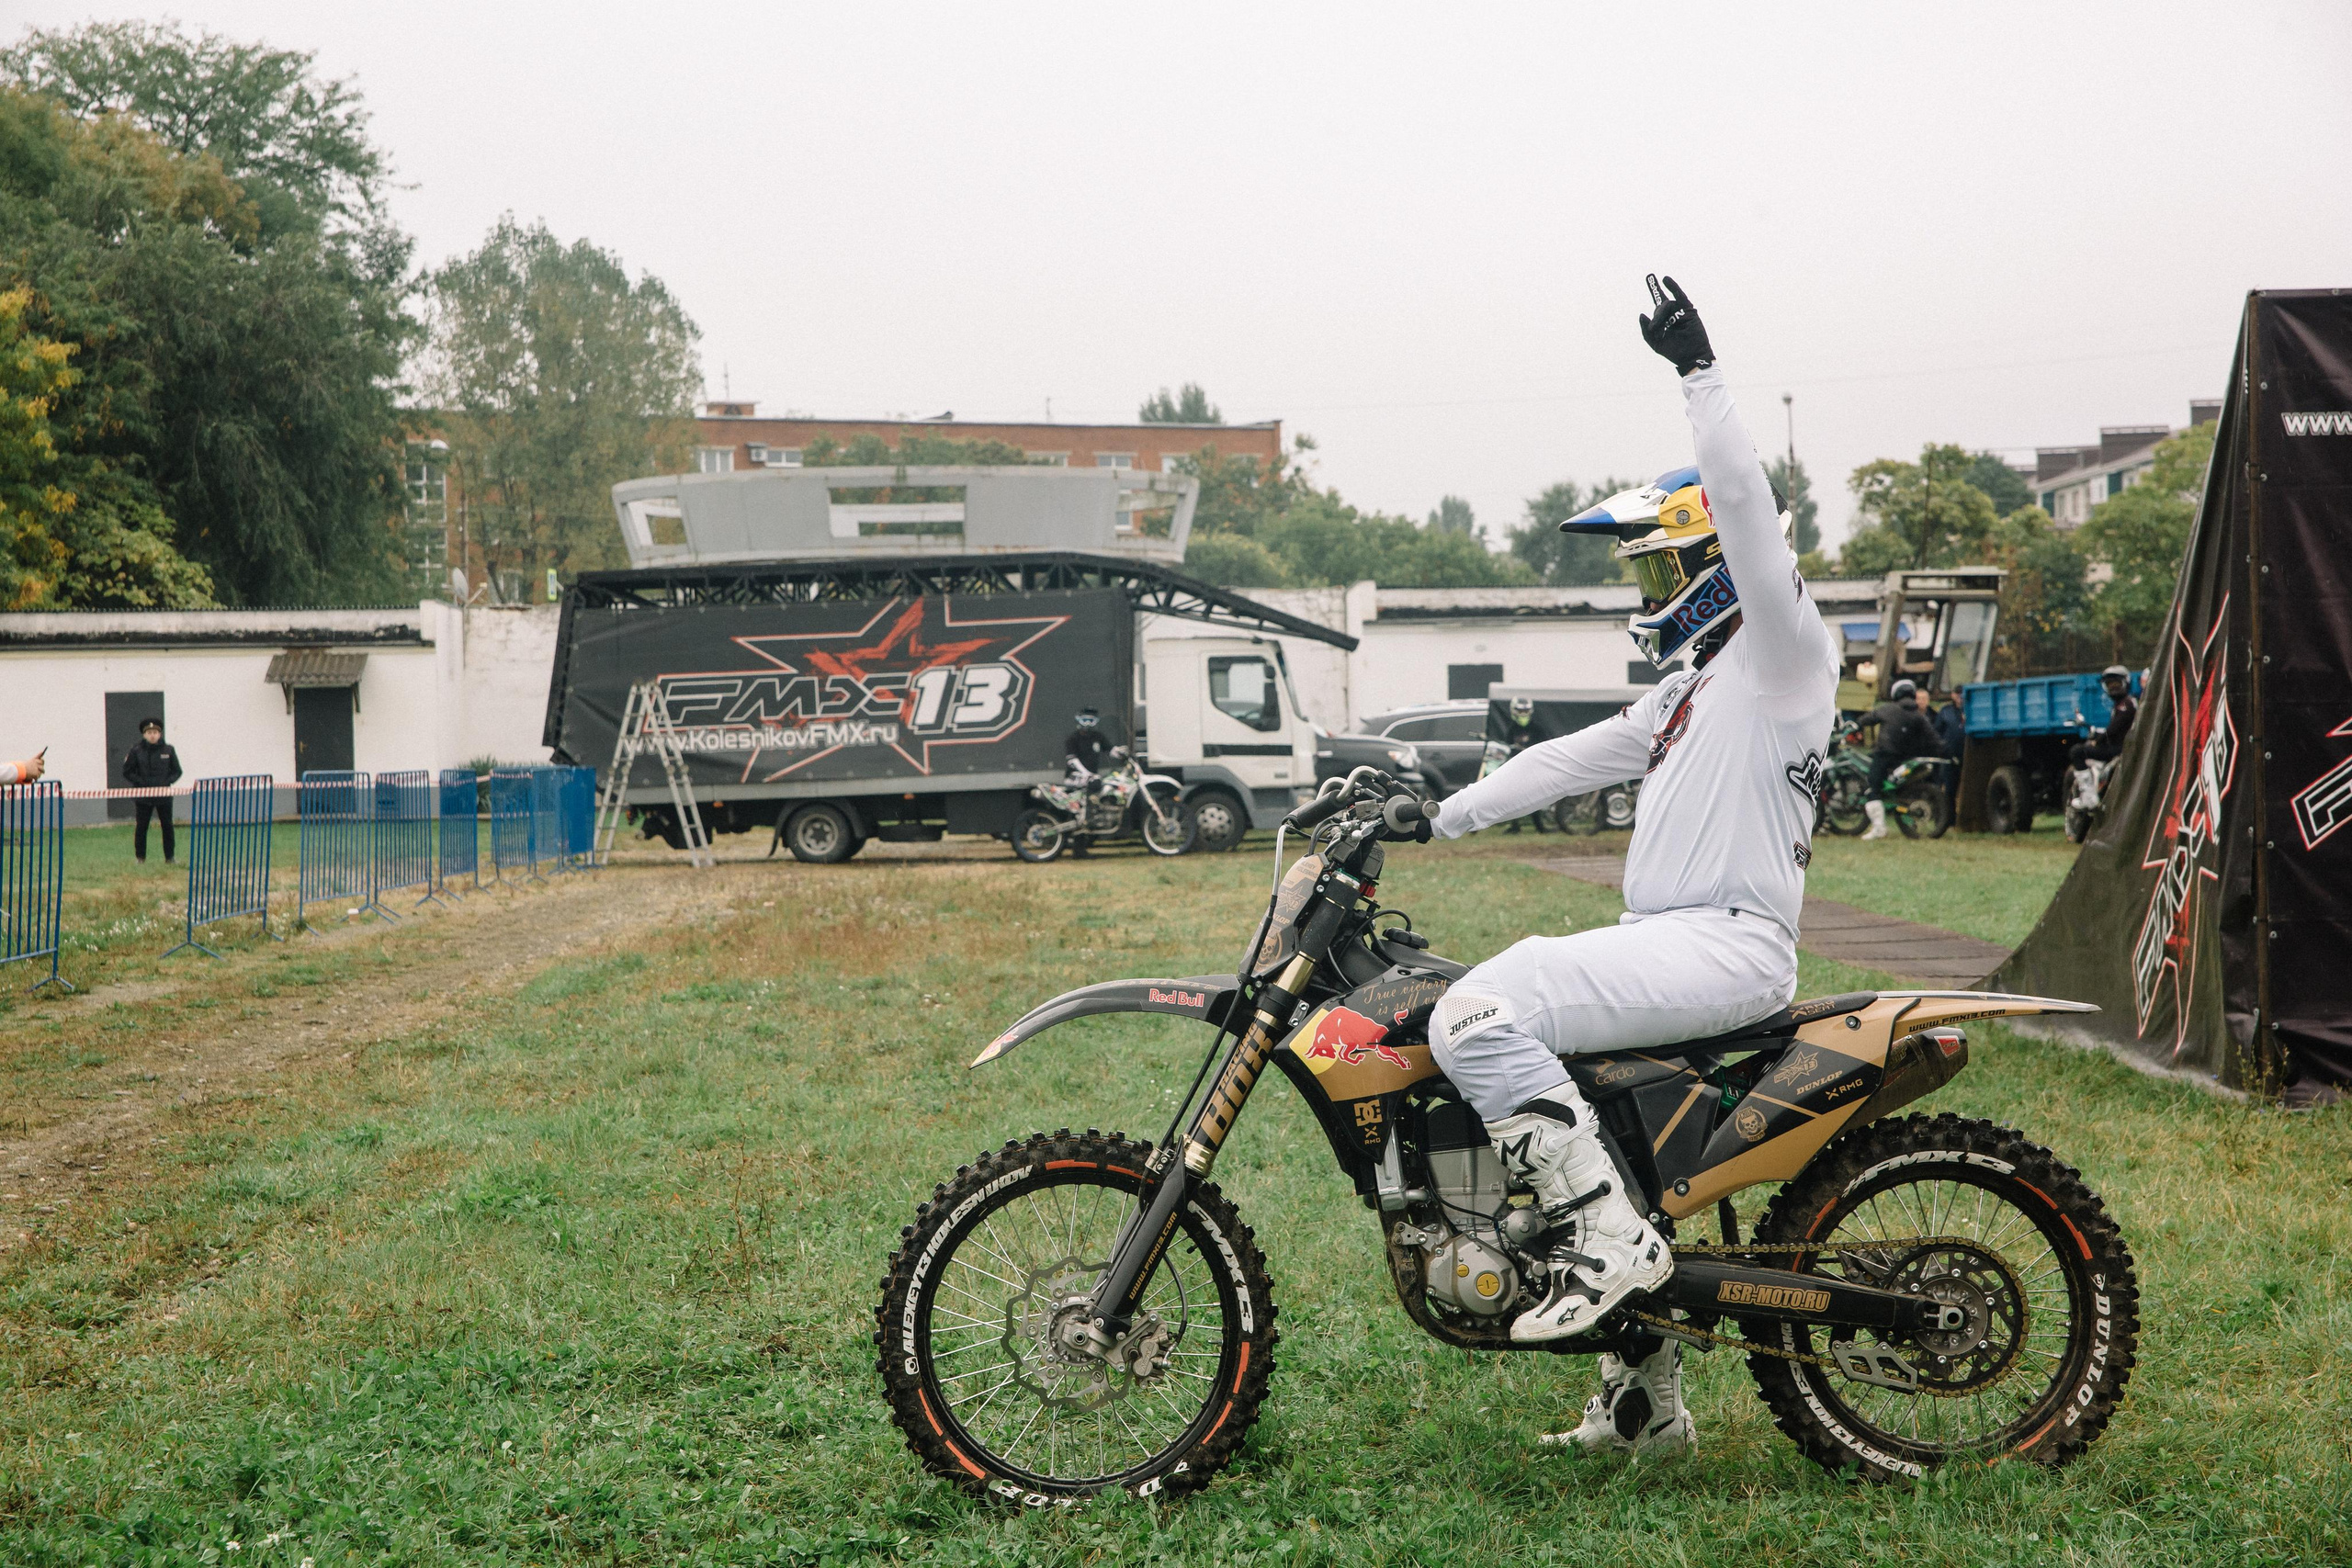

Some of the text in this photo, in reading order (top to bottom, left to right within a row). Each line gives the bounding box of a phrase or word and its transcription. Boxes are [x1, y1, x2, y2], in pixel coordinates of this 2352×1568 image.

[1148, 987, 1205, 1008] Red Bull
[1363, 977, 1449, 1005] True victory
[1391, 991, 1420, 1016] self
[1218, 1022, 1259, 1090] RACING
[1595, 1066, 1635, 1086] cardo
[1796, 1070, 1843, 1095] DUNLOP
[1838, 1078, 1863, 1094] RMG
[1718, 1281, 1830, 1312] XSR-MOTO.RU
[2065, 1293, 2113, 1430] DUNLOP
